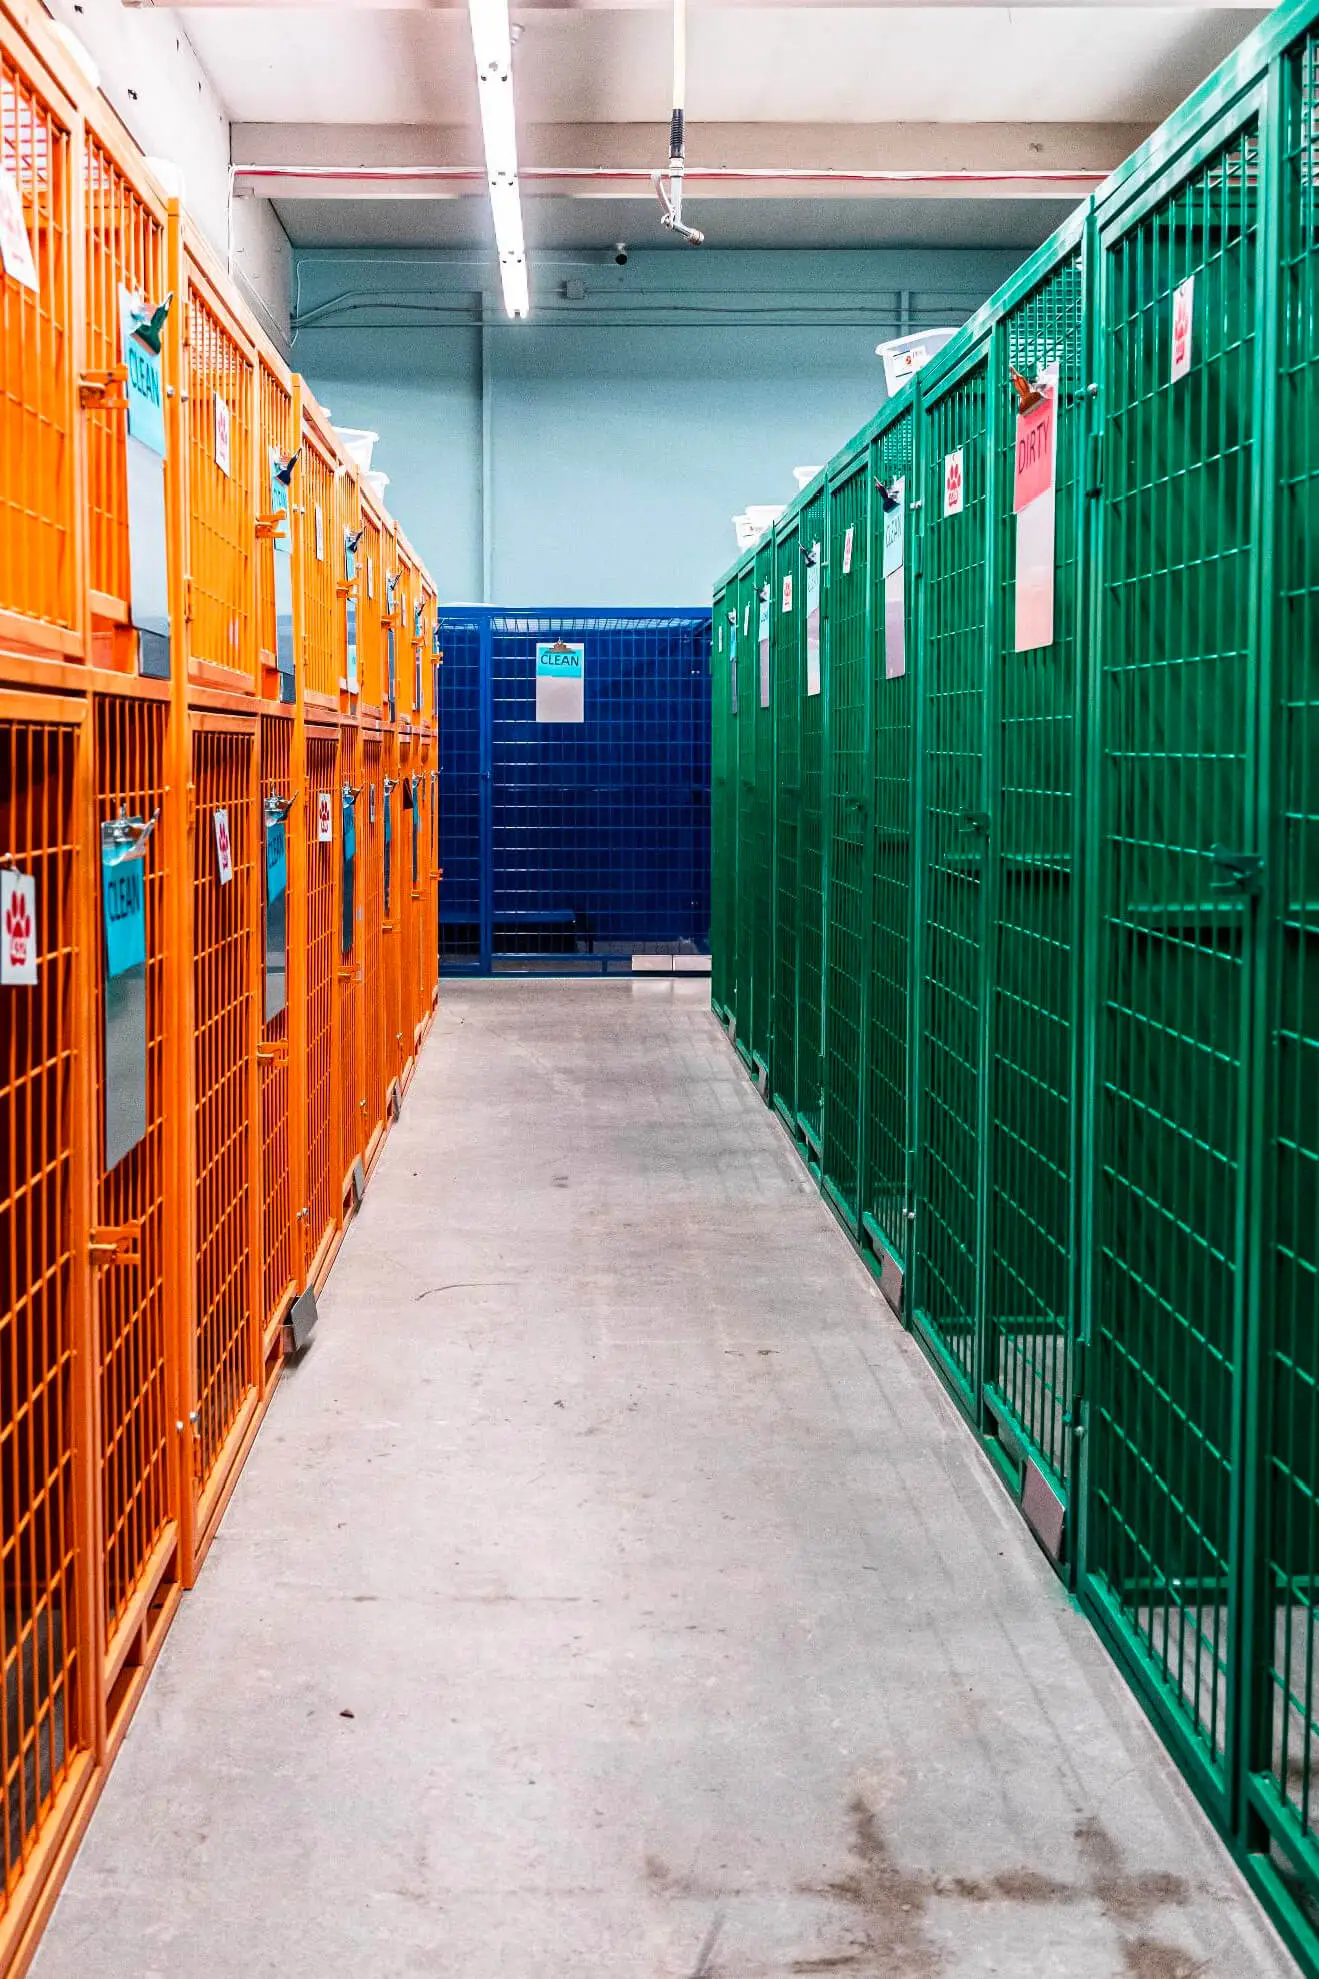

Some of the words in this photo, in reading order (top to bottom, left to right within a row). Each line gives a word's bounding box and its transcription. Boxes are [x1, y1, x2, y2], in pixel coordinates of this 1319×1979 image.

[129, 347, 160, 408] CLEAN
[1018, 415, 1050, 475] DIRTY
[540, 654, 579, 667] CLEAN
[107, 873, 141, 922] CLEAN
